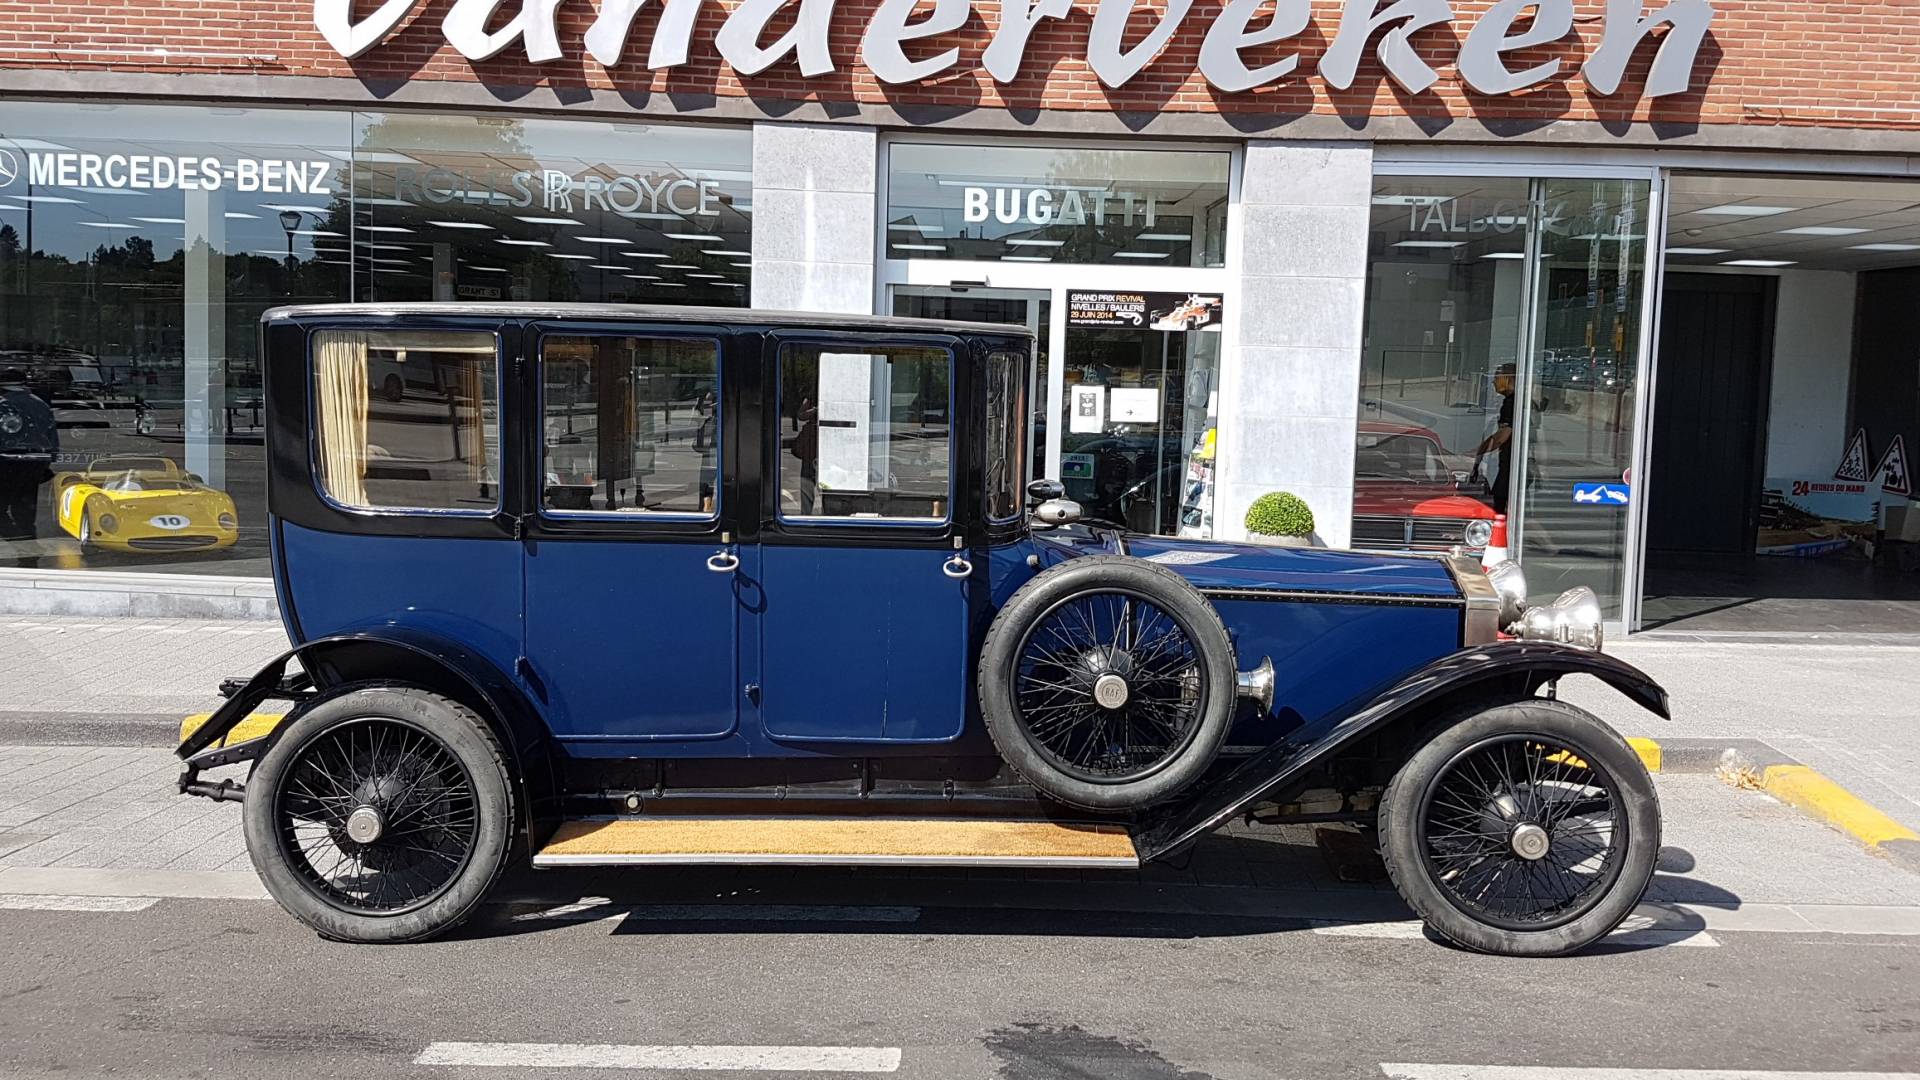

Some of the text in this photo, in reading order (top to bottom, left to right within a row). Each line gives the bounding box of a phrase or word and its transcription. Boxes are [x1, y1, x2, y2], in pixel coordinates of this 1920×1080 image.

[28, 152, 331, 195] MERCEDES-BENZ
[394, 167, 535, 208] ROLLS
[583, 175, 721, 216] ROYCE
[963, 187, 1156, 227] BUGATTI
[1071, 294, 1097, 302] GRAND
[1116, 295, 1145, 303] REVIVAL
[1071, 303, 1106, 311] NIVELLES
[1110, 304, 1145, 312] BAULERS
[56, 453, 80, 464] 337
[1792, 480, 1809, 496] 24
[158, 517, 181, 527] 10
